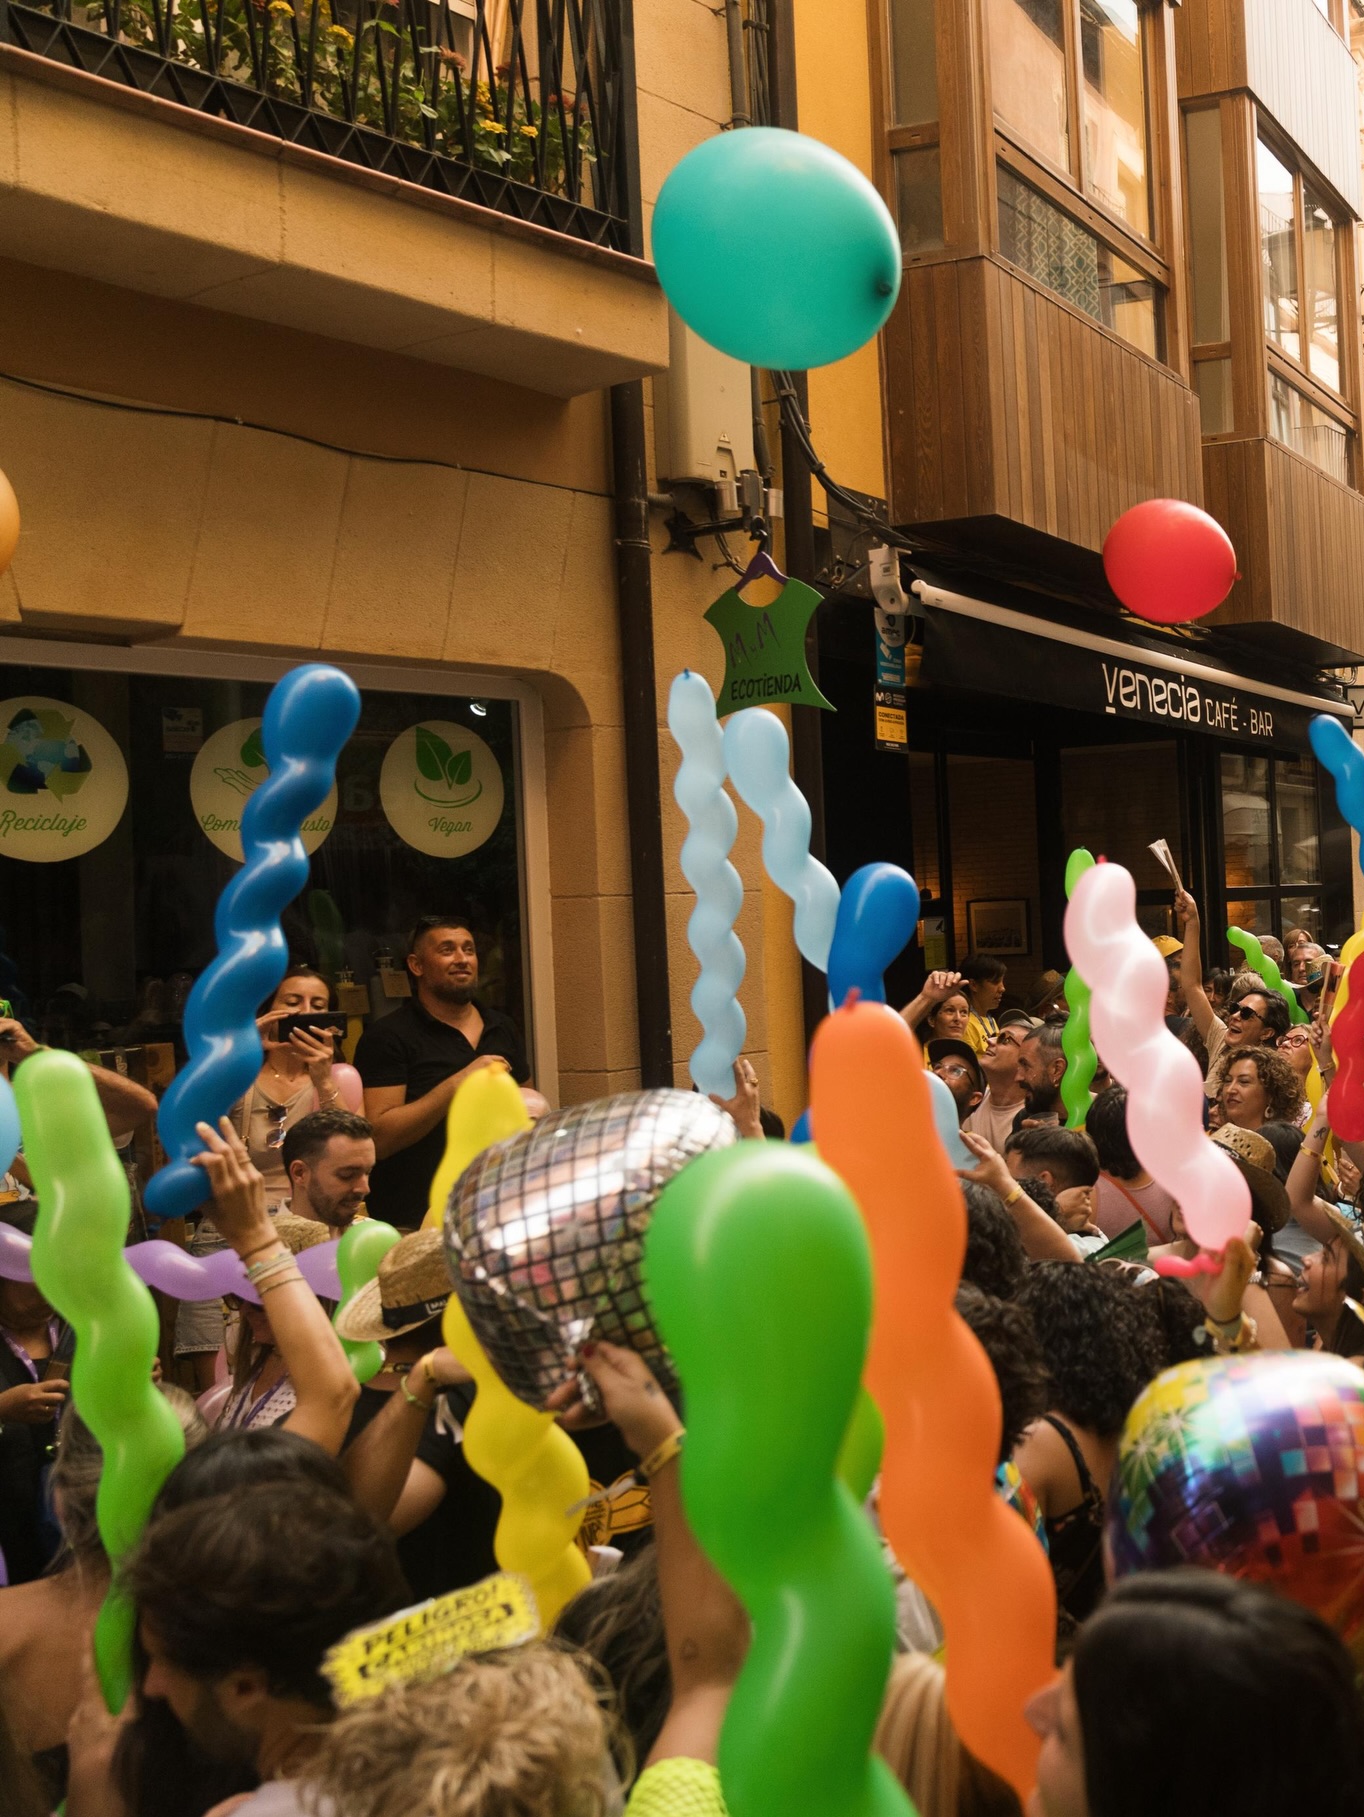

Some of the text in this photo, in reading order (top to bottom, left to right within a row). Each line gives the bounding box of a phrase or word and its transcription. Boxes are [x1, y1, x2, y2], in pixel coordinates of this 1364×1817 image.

[1205, 698, 1239, 732] CAFÉ
[1251, 709, 1274, 738] BAR
[0, 809, 88, 838] Reciclaje
[428, 816, 473, 838] Vegan
